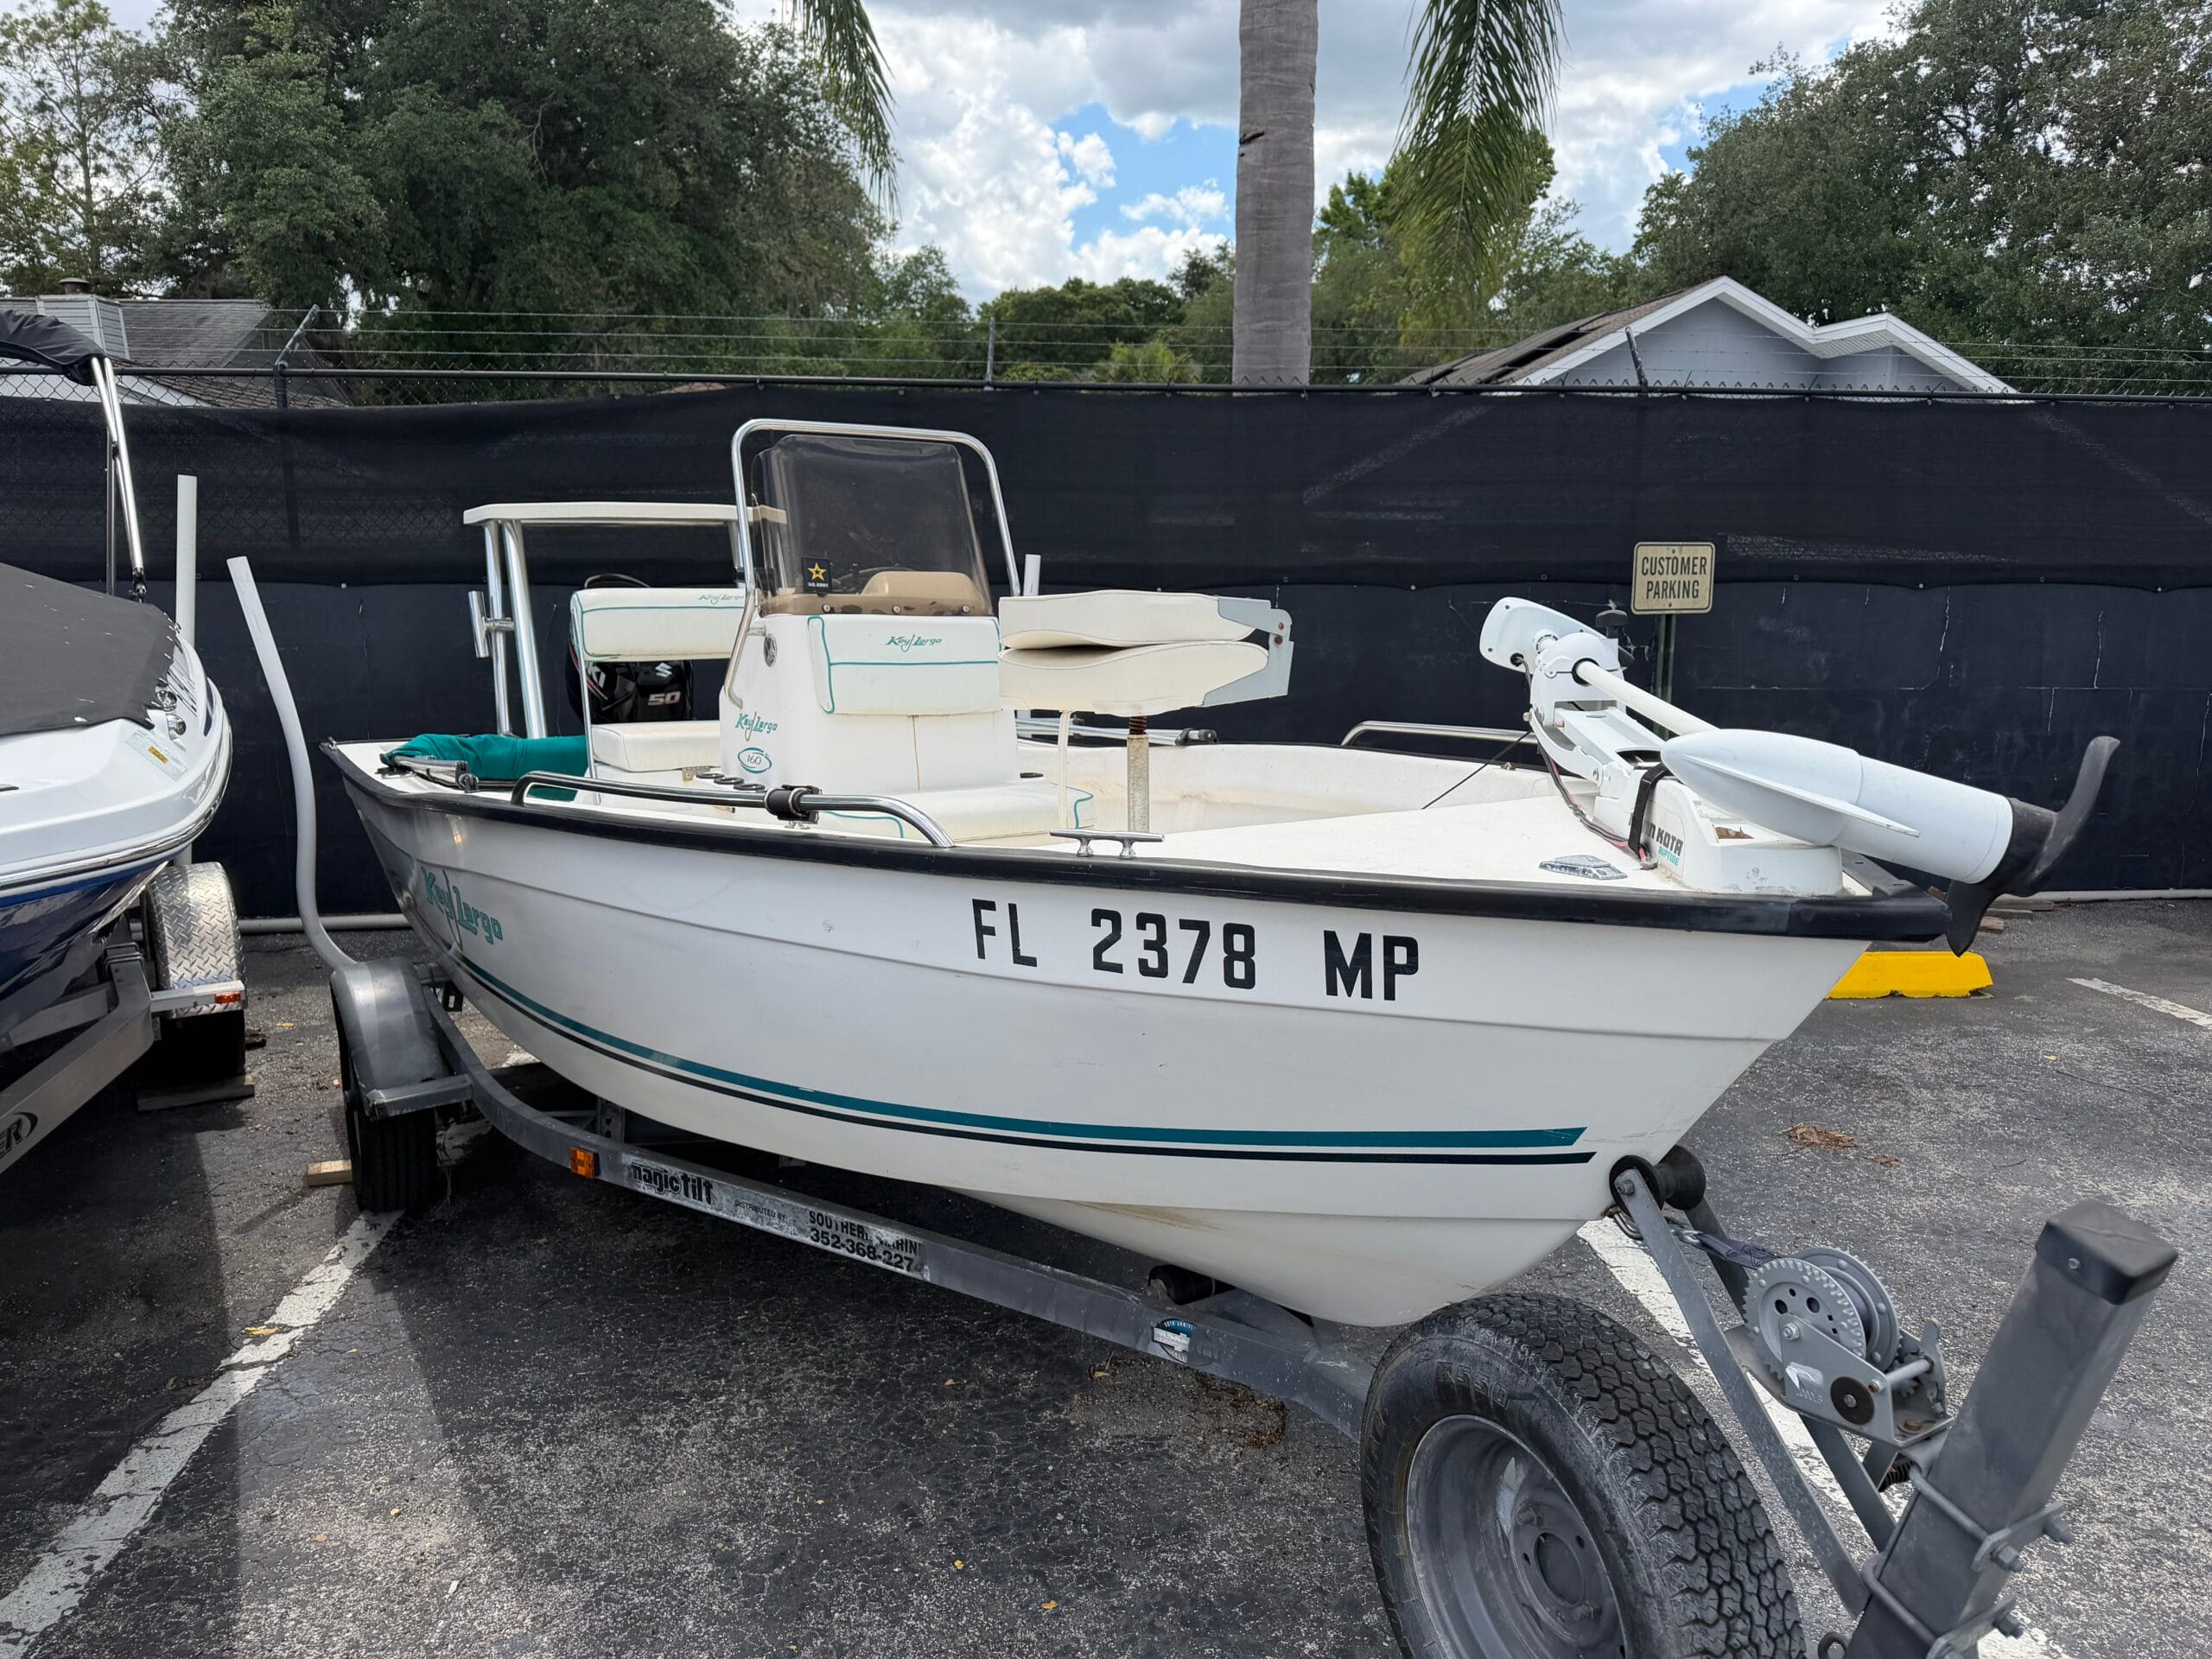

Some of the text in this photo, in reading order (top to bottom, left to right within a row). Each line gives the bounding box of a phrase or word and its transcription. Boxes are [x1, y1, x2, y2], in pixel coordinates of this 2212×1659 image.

[1642, 556, 1707, 575] CUSTOMER
[1646, 580, 1700, 599] PARKING
[885, 634, 942, 652] Key Largo
[648, 691, 681, 706] 50
[735, 712, 779, 741] Key Largo
[747, 753, 762, 766] 160
[1656, 827, 1684, 857] KOTA
[453, 886, 504, 945] Largo
[972, 898, 1419, 1001] FL 2378 MP
[734, 1199, 776, 1217] DISTRIBUTED
